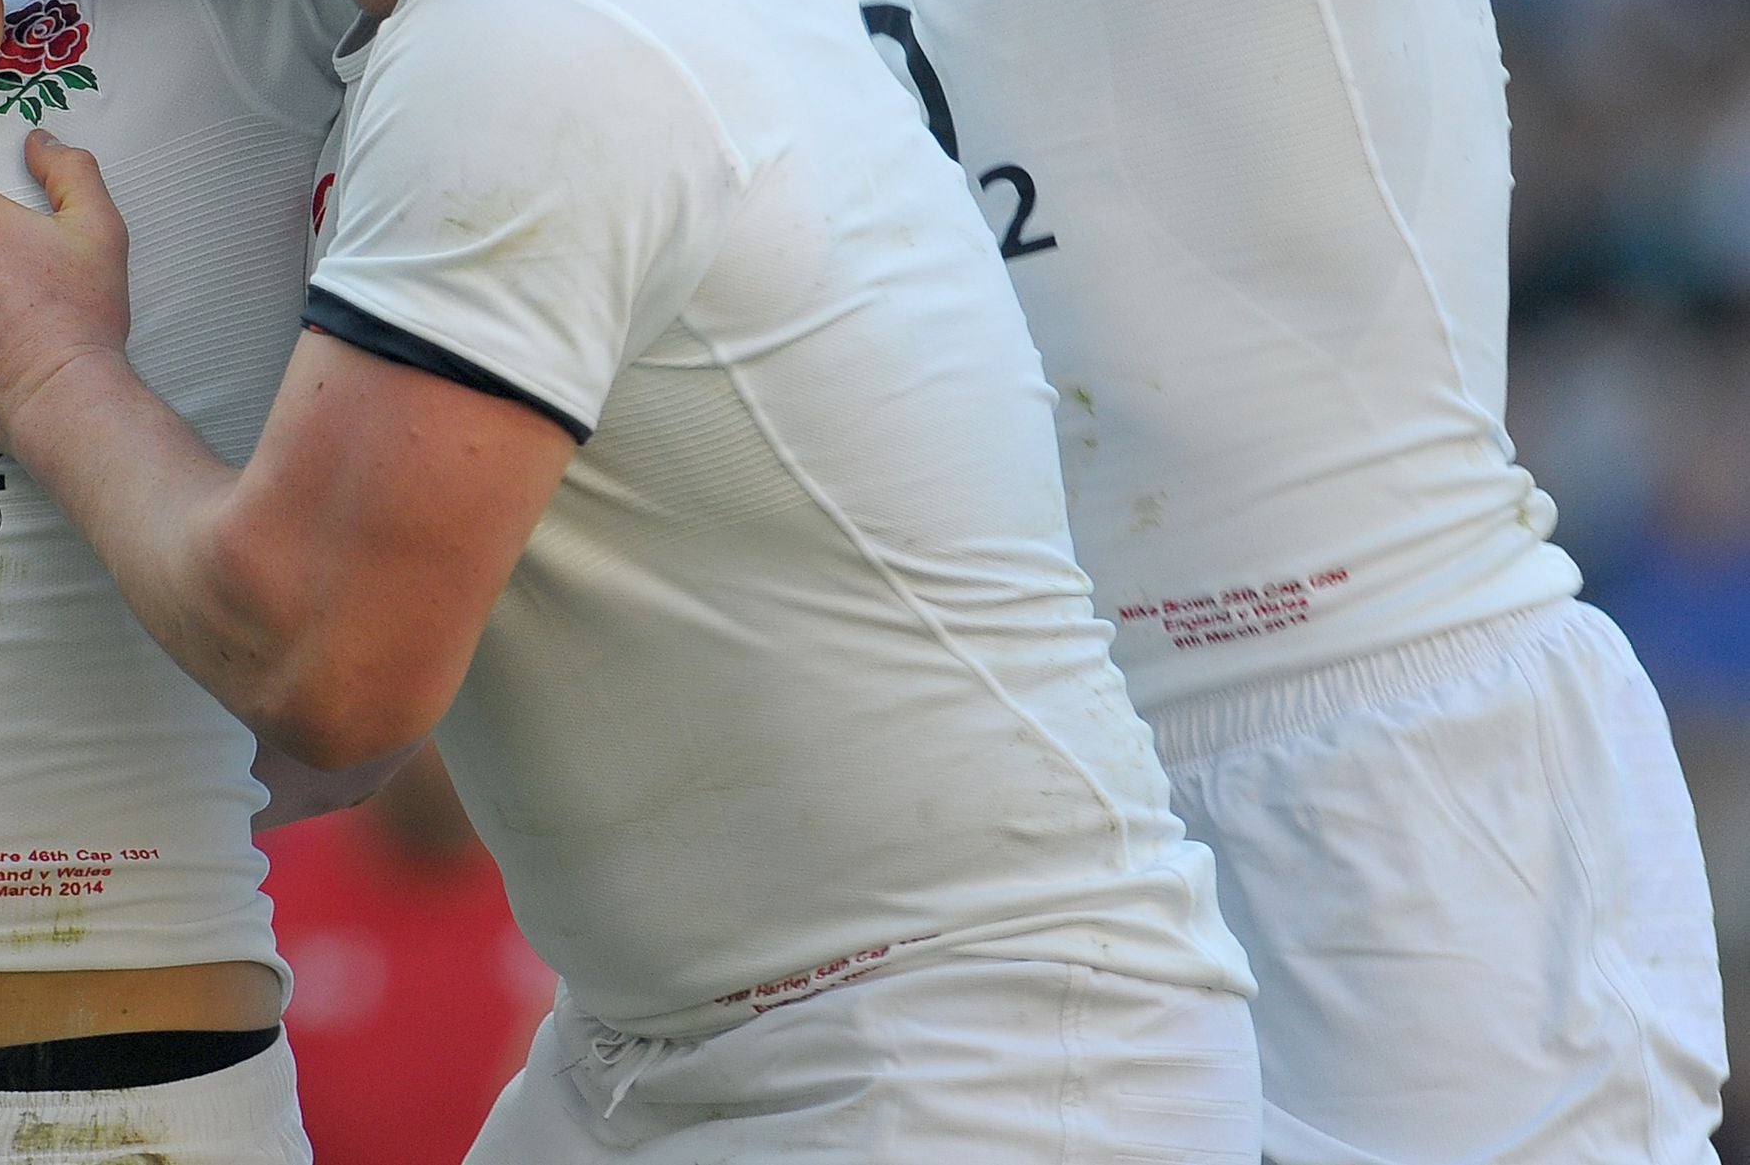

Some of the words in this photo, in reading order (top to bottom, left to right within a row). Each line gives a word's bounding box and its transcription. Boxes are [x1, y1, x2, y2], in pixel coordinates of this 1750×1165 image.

[27, 849, 69, 862] 46th
[76, 849, 113, 863] Cap
[120, 848, 160, 861] 1301
[39, 869, 50, 879] v
[57, 866, 113, 879] Wales
[59, 880, 104, 896] 2014
